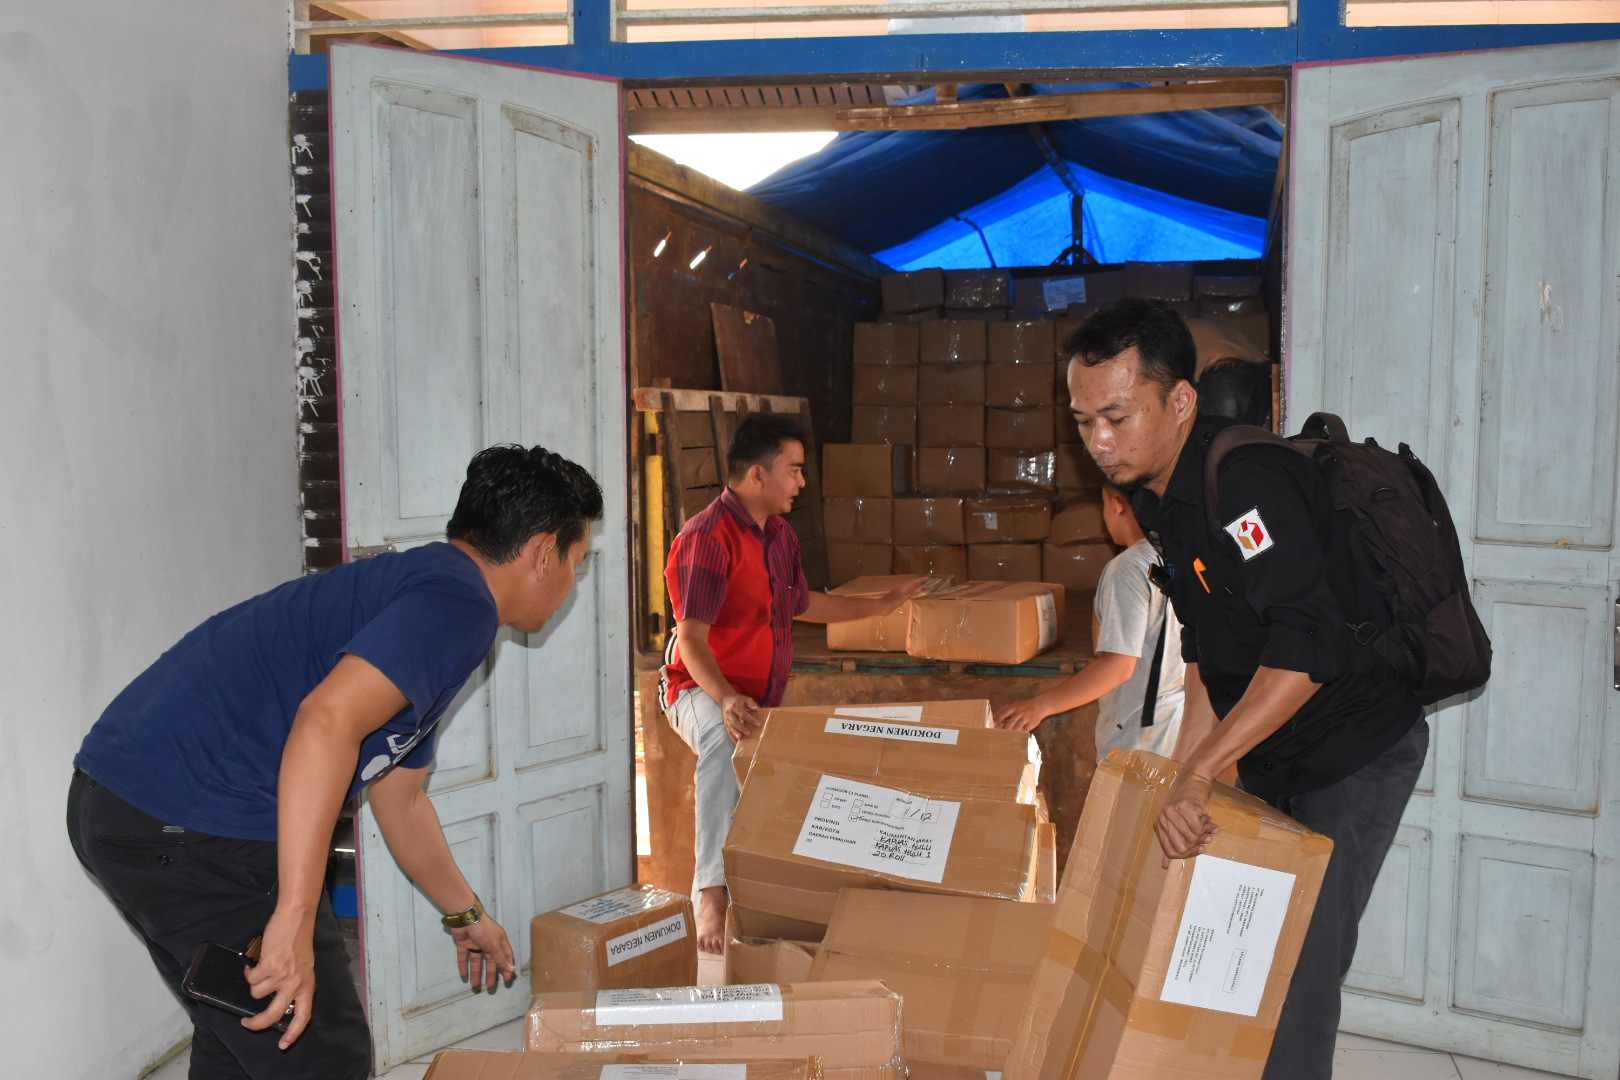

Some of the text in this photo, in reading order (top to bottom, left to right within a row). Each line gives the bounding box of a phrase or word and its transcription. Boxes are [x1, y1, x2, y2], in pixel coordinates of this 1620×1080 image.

[841, 722, 942, 739] DOKUMEN NEGARA
[814, 816, 840, 826] PROVINSI
[811, 824, 840, 834] KAB/KOTA
[808, 832, 829, 840] DAERAH
[880, 830, 915, 842] KALIMANTAN
[874, 842, 901, 852] KAPUAS
[610, 920, 682, 956] DOKUMEN NEGARA
